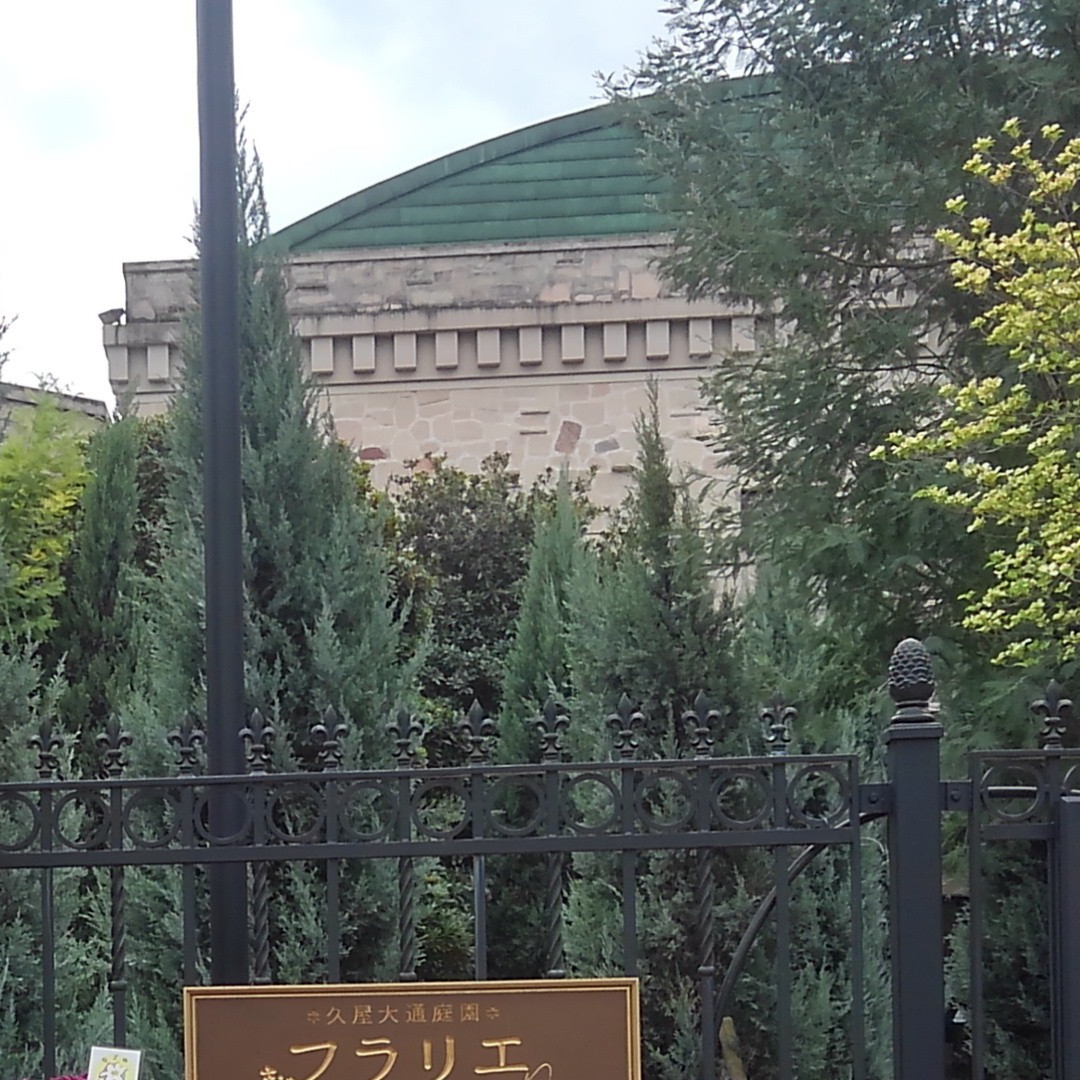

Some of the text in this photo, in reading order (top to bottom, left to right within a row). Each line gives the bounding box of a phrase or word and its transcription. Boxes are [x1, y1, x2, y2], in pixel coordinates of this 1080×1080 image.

[326, 1002, 480, 1025] 久屋大通庭園
